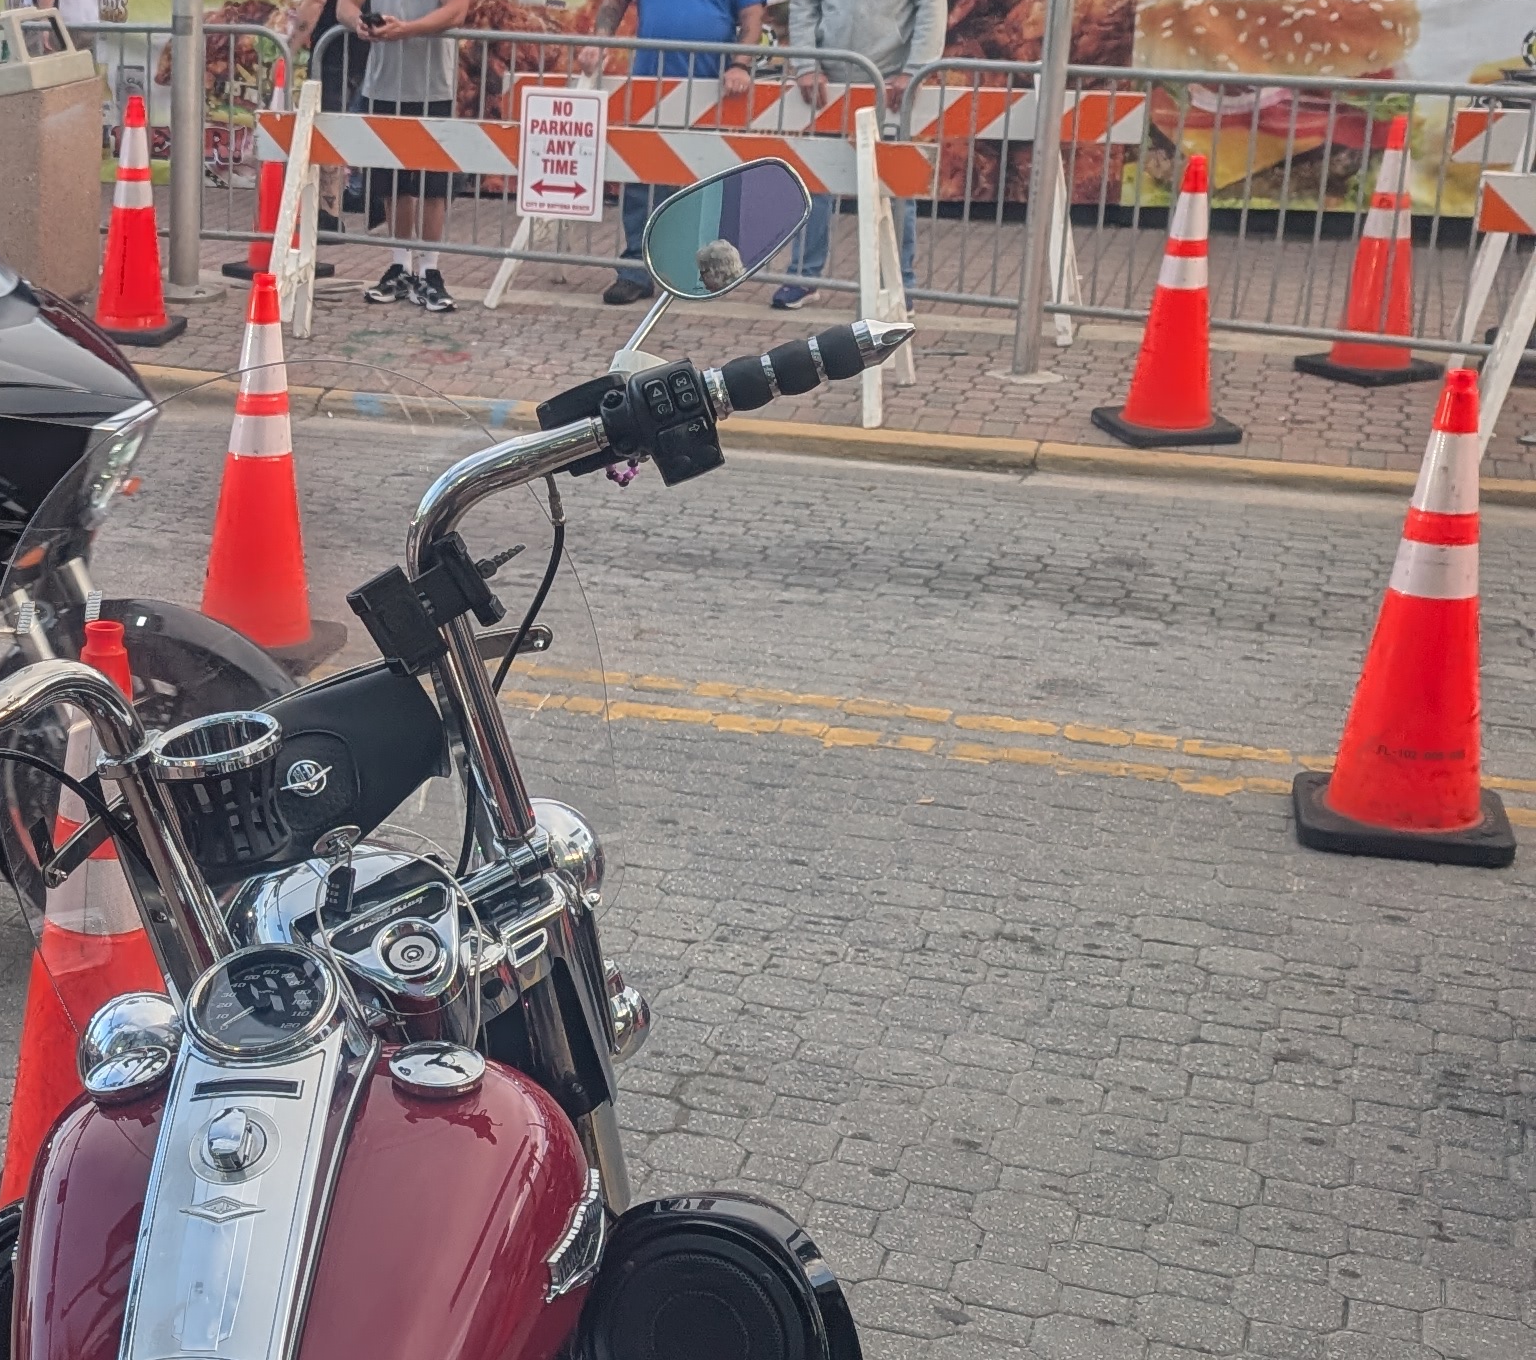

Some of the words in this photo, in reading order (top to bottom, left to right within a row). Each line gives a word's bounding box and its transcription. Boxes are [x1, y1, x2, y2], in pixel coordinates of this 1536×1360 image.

[552, 100, 573, 117] NO
[530, 118, 594, 138] PARKING
[545, 139, 576, 157] ANY
[541, 158, 578, 176] TIME
